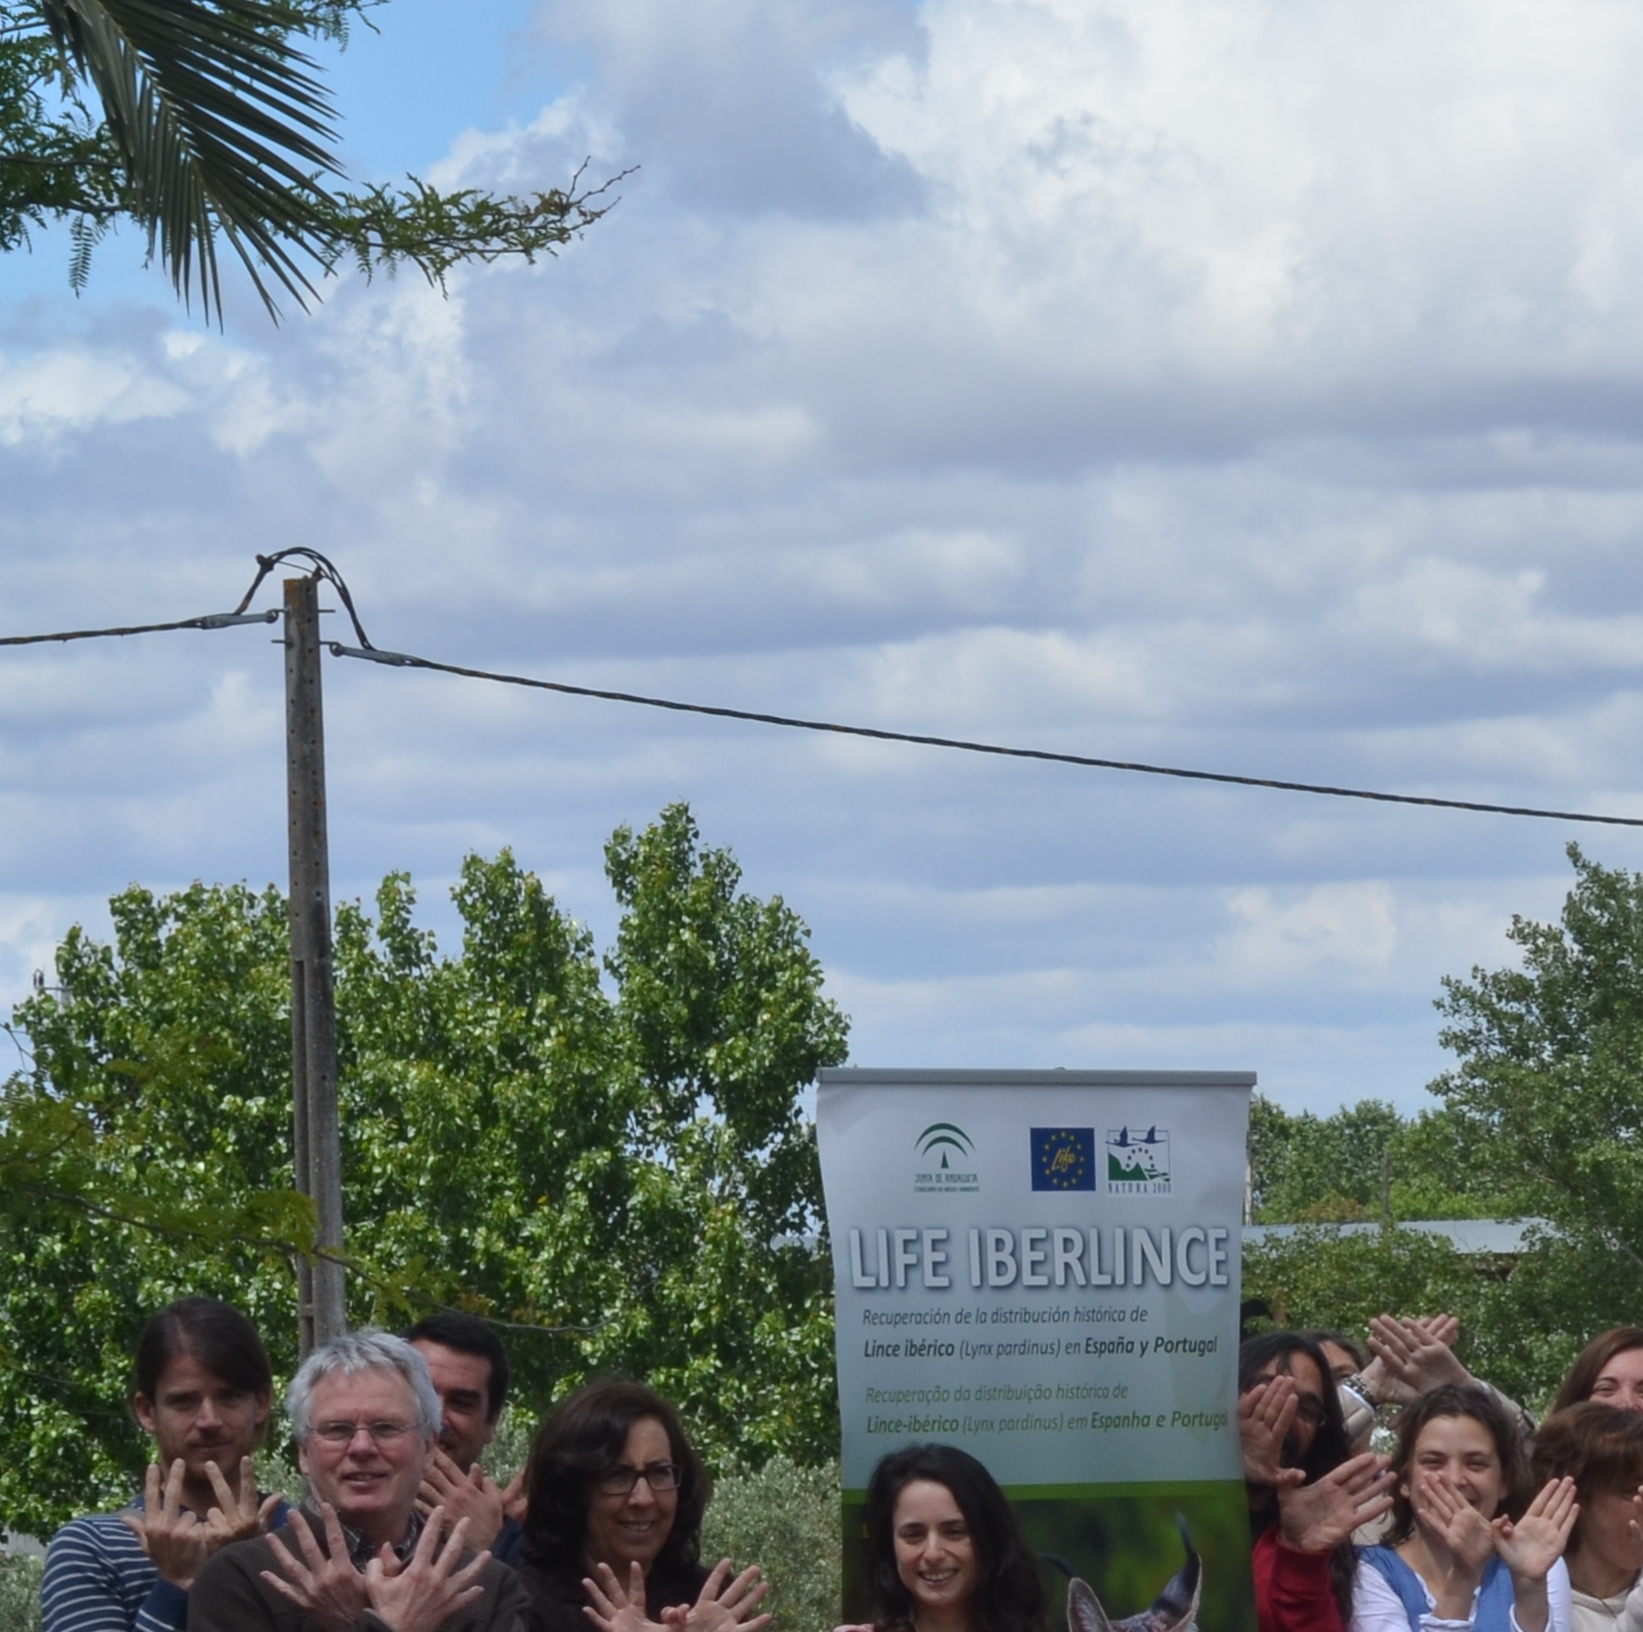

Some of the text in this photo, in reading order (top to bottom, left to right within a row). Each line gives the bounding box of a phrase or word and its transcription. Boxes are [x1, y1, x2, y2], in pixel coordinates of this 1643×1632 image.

[1108, 1182, 1148, 1194] NATURA
[850, 1226, 1229, 1289] LIFE IBERLINCE
[862, 1305, 1149, 1328] Recuperación de la distribución histórica de
[863, 1335, 1218, 1360] Lince ibérico (Lynx pardinus) en España y Portugal
[866, 1383, 1129, 1406] Recuperação da distribuição histórica de
[867, 1415, 959, 1433] Lince-ibérico
[962, 1415, 995, 1435] (Lynx
[998, 1413, 1064, 1434] pardinus)
[1068, 1417, 1088, 1430] em
[1091, 1410, 1151, 1432] Espanha
[1156, 1414, 1166, 1428] e
